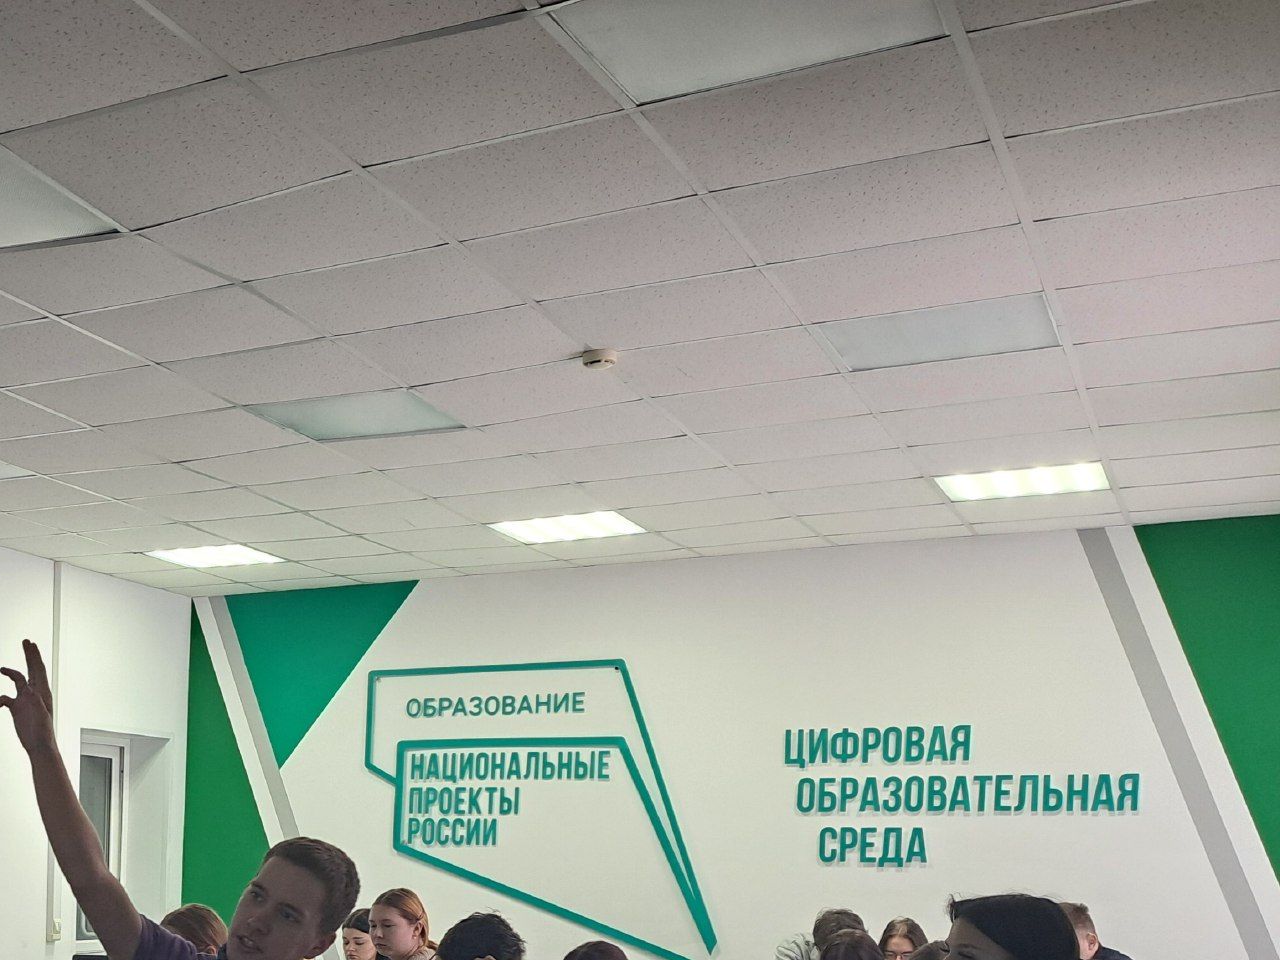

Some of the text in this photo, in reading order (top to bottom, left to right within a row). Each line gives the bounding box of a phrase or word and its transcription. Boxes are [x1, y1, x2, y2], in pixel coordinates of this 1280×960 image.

[406, 692, 586, 718] ОБРАЗОВАНИЕ
[784, 725, 971, 768] ЦИФРОВАЯ
[410, 751, 610, 783] НАЦИОНАЛЬНЫЕ
[408, 787, 520, 816] ПРОЕКТЫ
[796, 773, 1141, 813] ОБРАЗОВАТЕЛЬНАЯ
[407, 817, 497, 846] РОССИИ
[819, 827, 928, 868] СРЕДА
